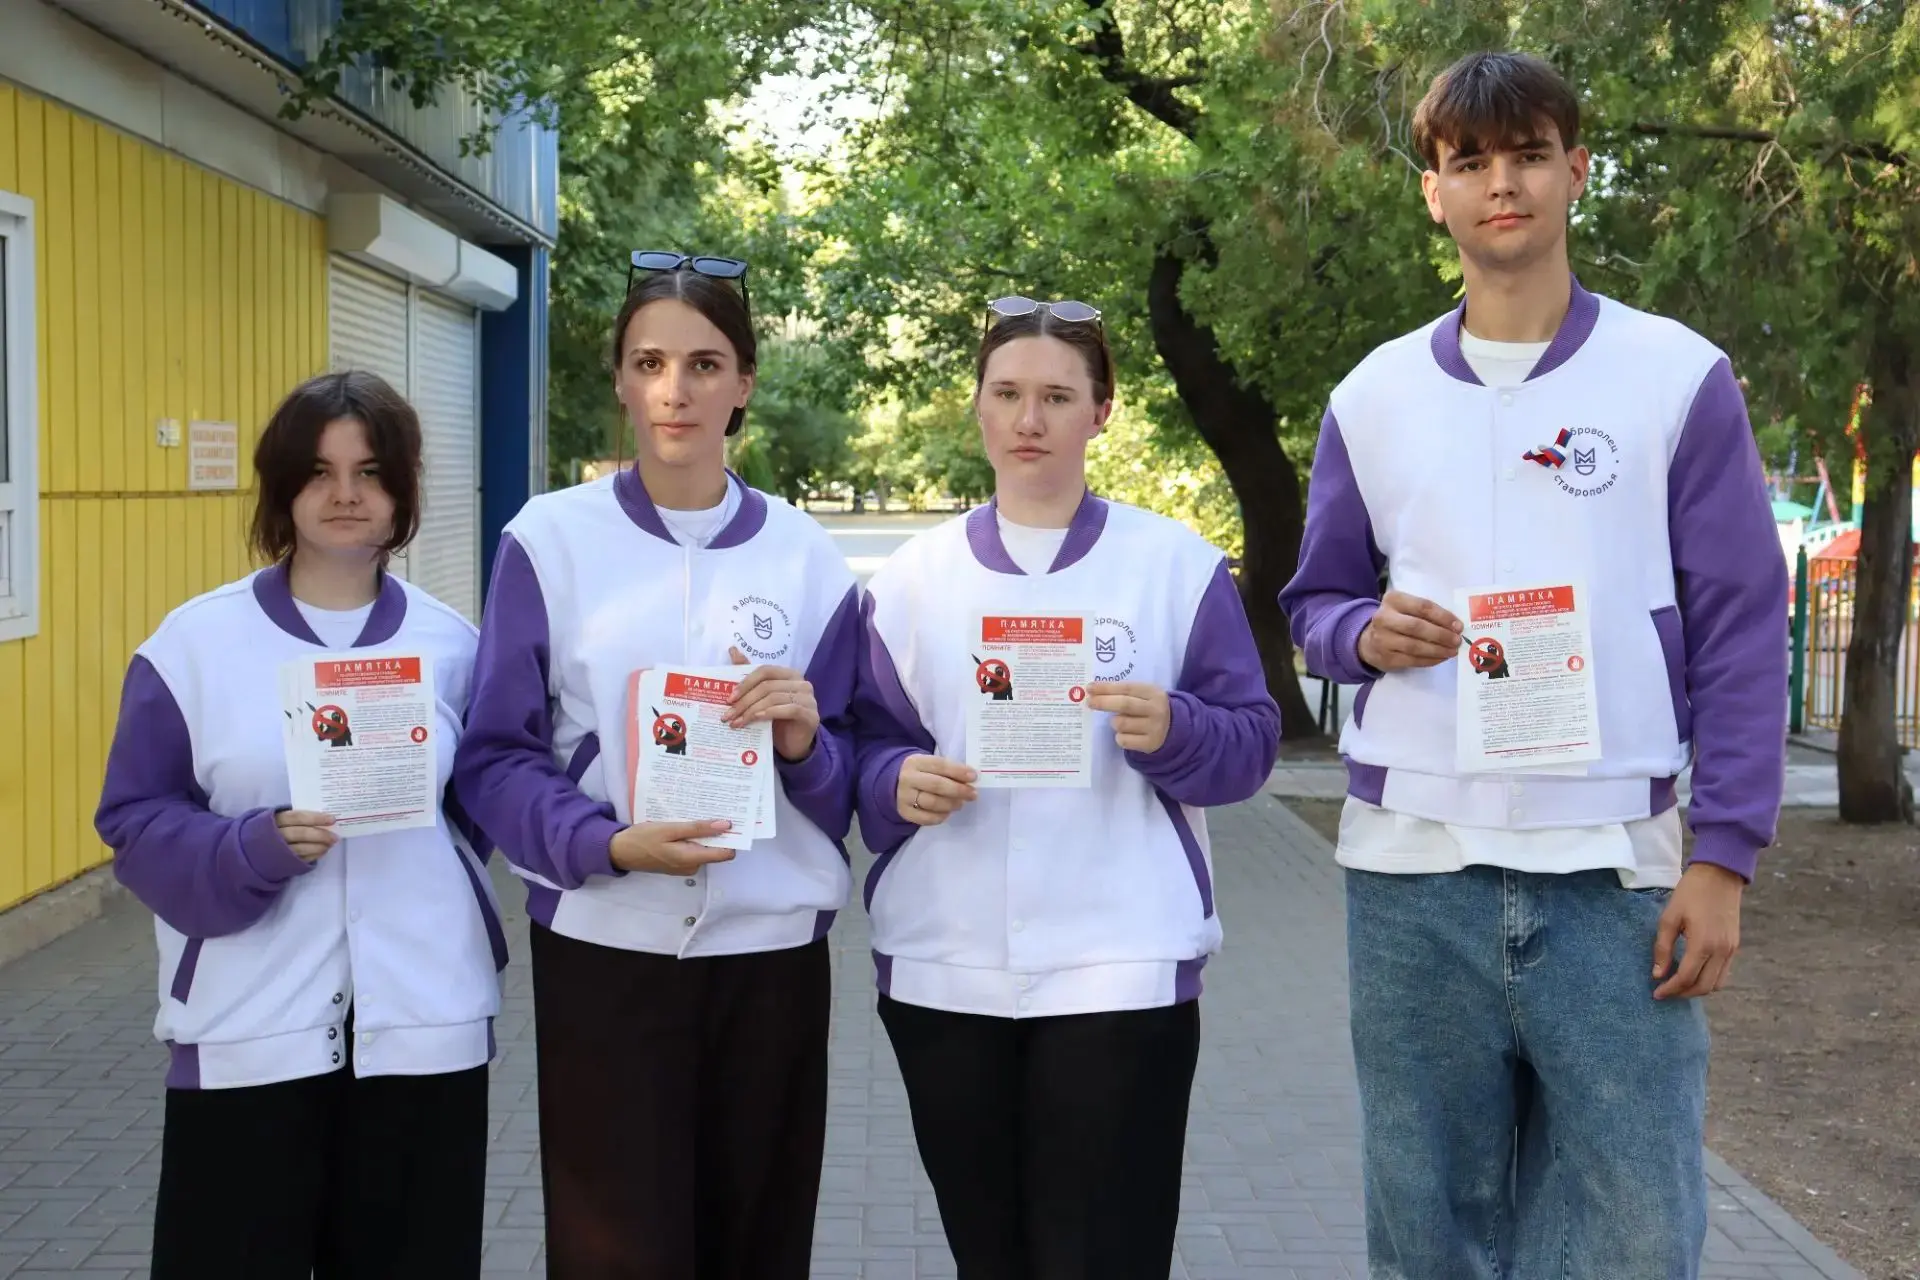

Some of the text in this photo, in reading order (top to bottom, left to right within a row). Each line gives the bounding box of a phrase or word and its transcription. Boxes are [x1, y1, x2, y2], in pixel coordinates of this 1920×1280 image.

[1569, 426, 1619, 454] броволец
[1554, 472, 1618, 498] ставрополья
[739, 594, 791, 627] доброволец
[1487, 590, 1554, 605] ПАМЯТКА
[999, 619, 1065, 629] ПАМЯТКА
[1095, 617, 1137, 644] роволец
[734, 631, 789, 660] ставрополья
[333, 661, 402, 673] ПАМЯТКА
[683, 677, 738, 692] ПАМЯТК
